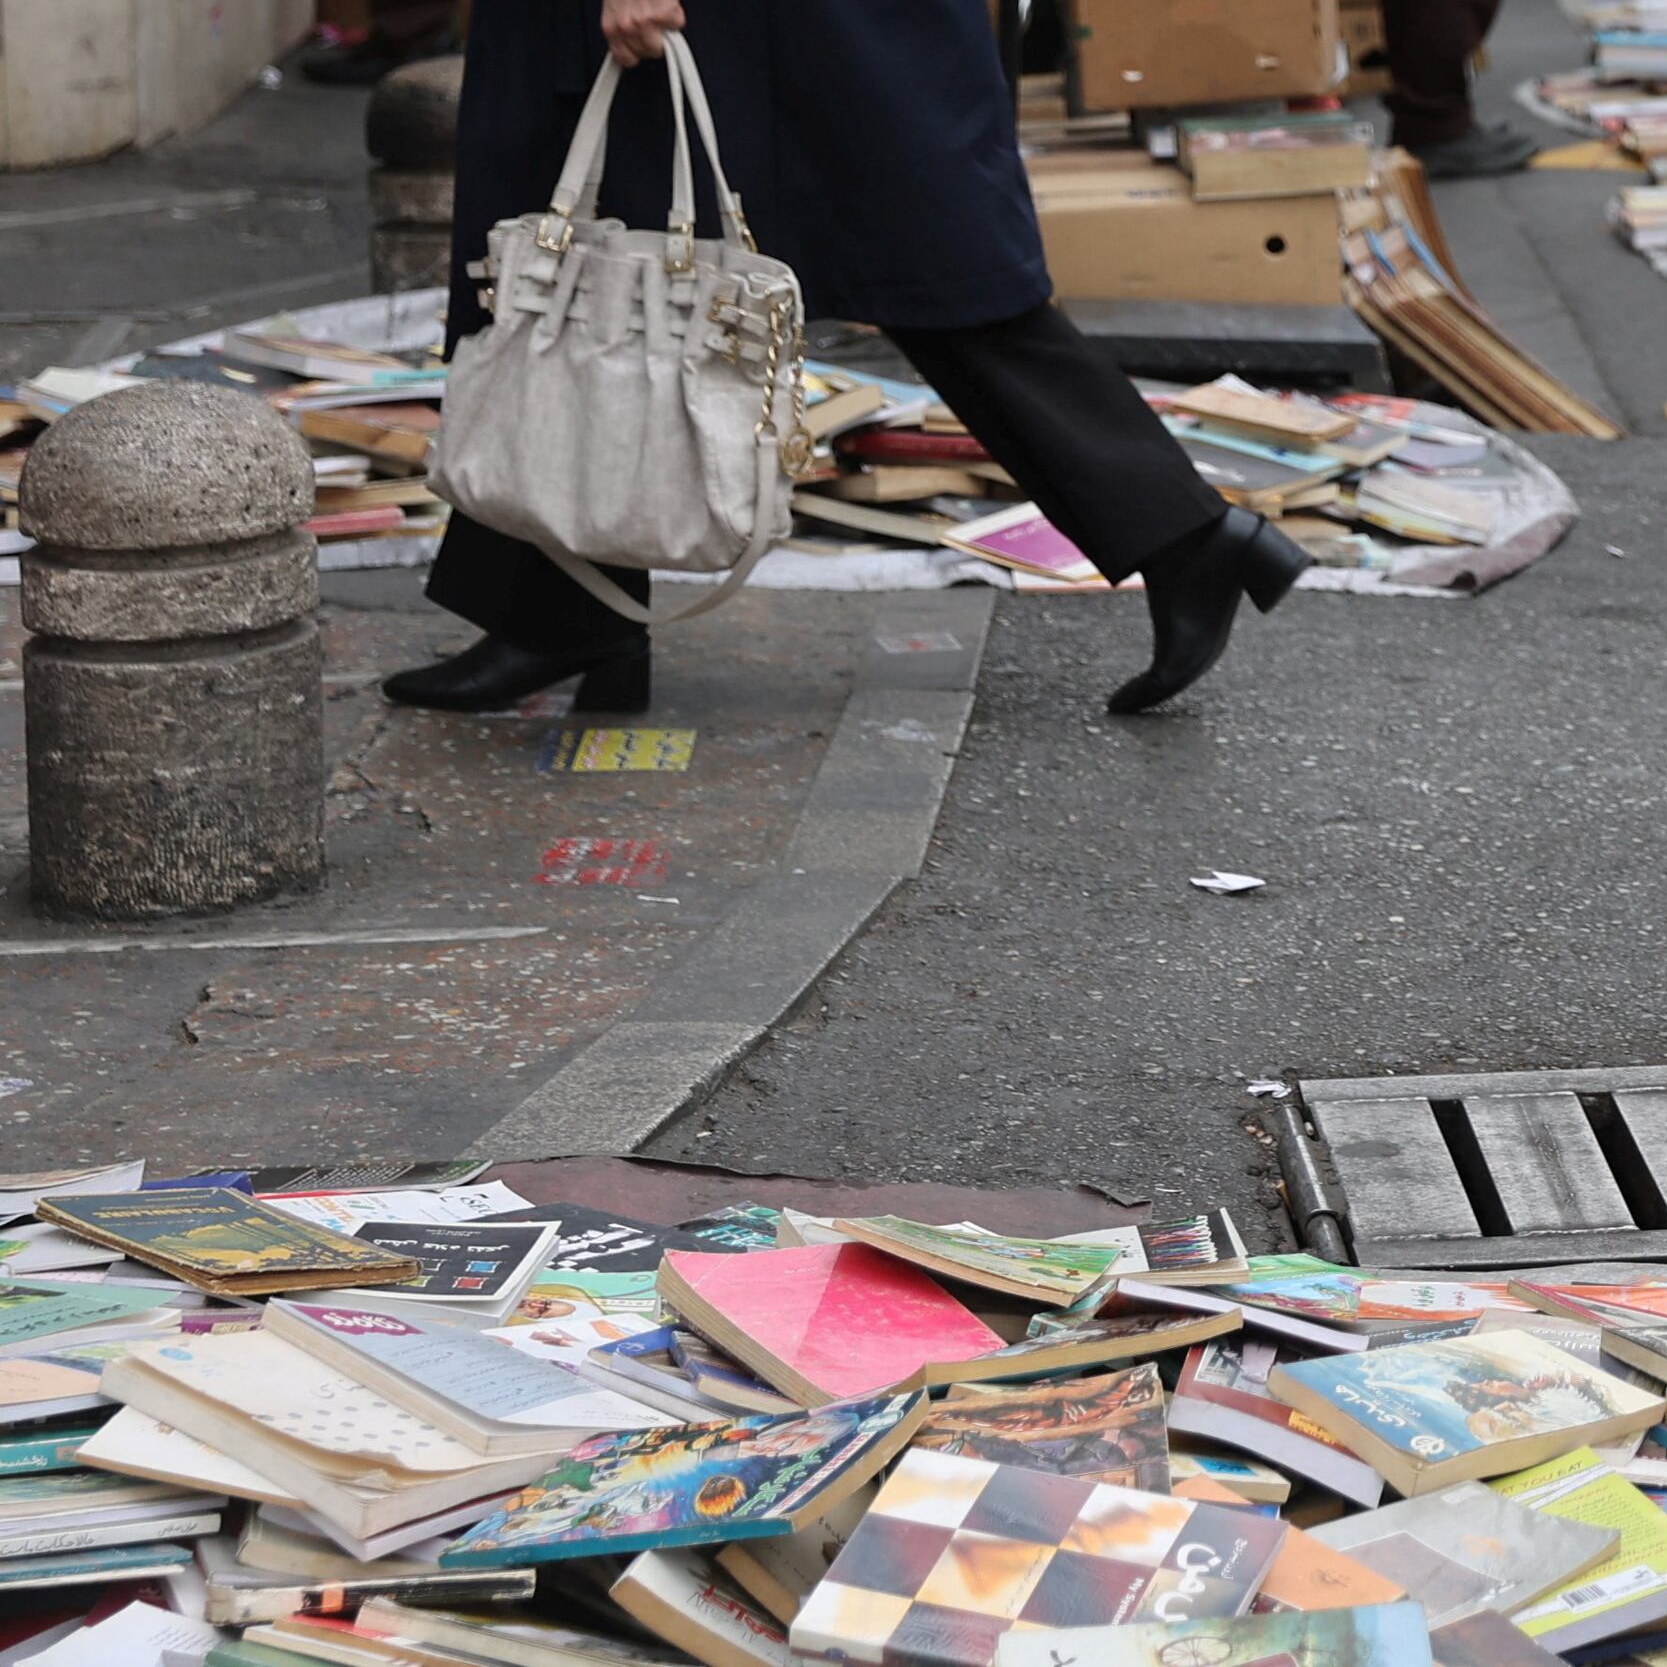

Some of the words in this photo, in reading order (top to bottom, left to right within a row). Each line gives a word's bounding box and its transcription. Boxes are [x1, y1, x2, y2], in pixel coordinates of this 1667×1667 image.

[1523, 1472, 1554, 1488] YOU
[1557, 1462, 1584, 1477] EAT
[1125, 1576, 1144, 1596] My
